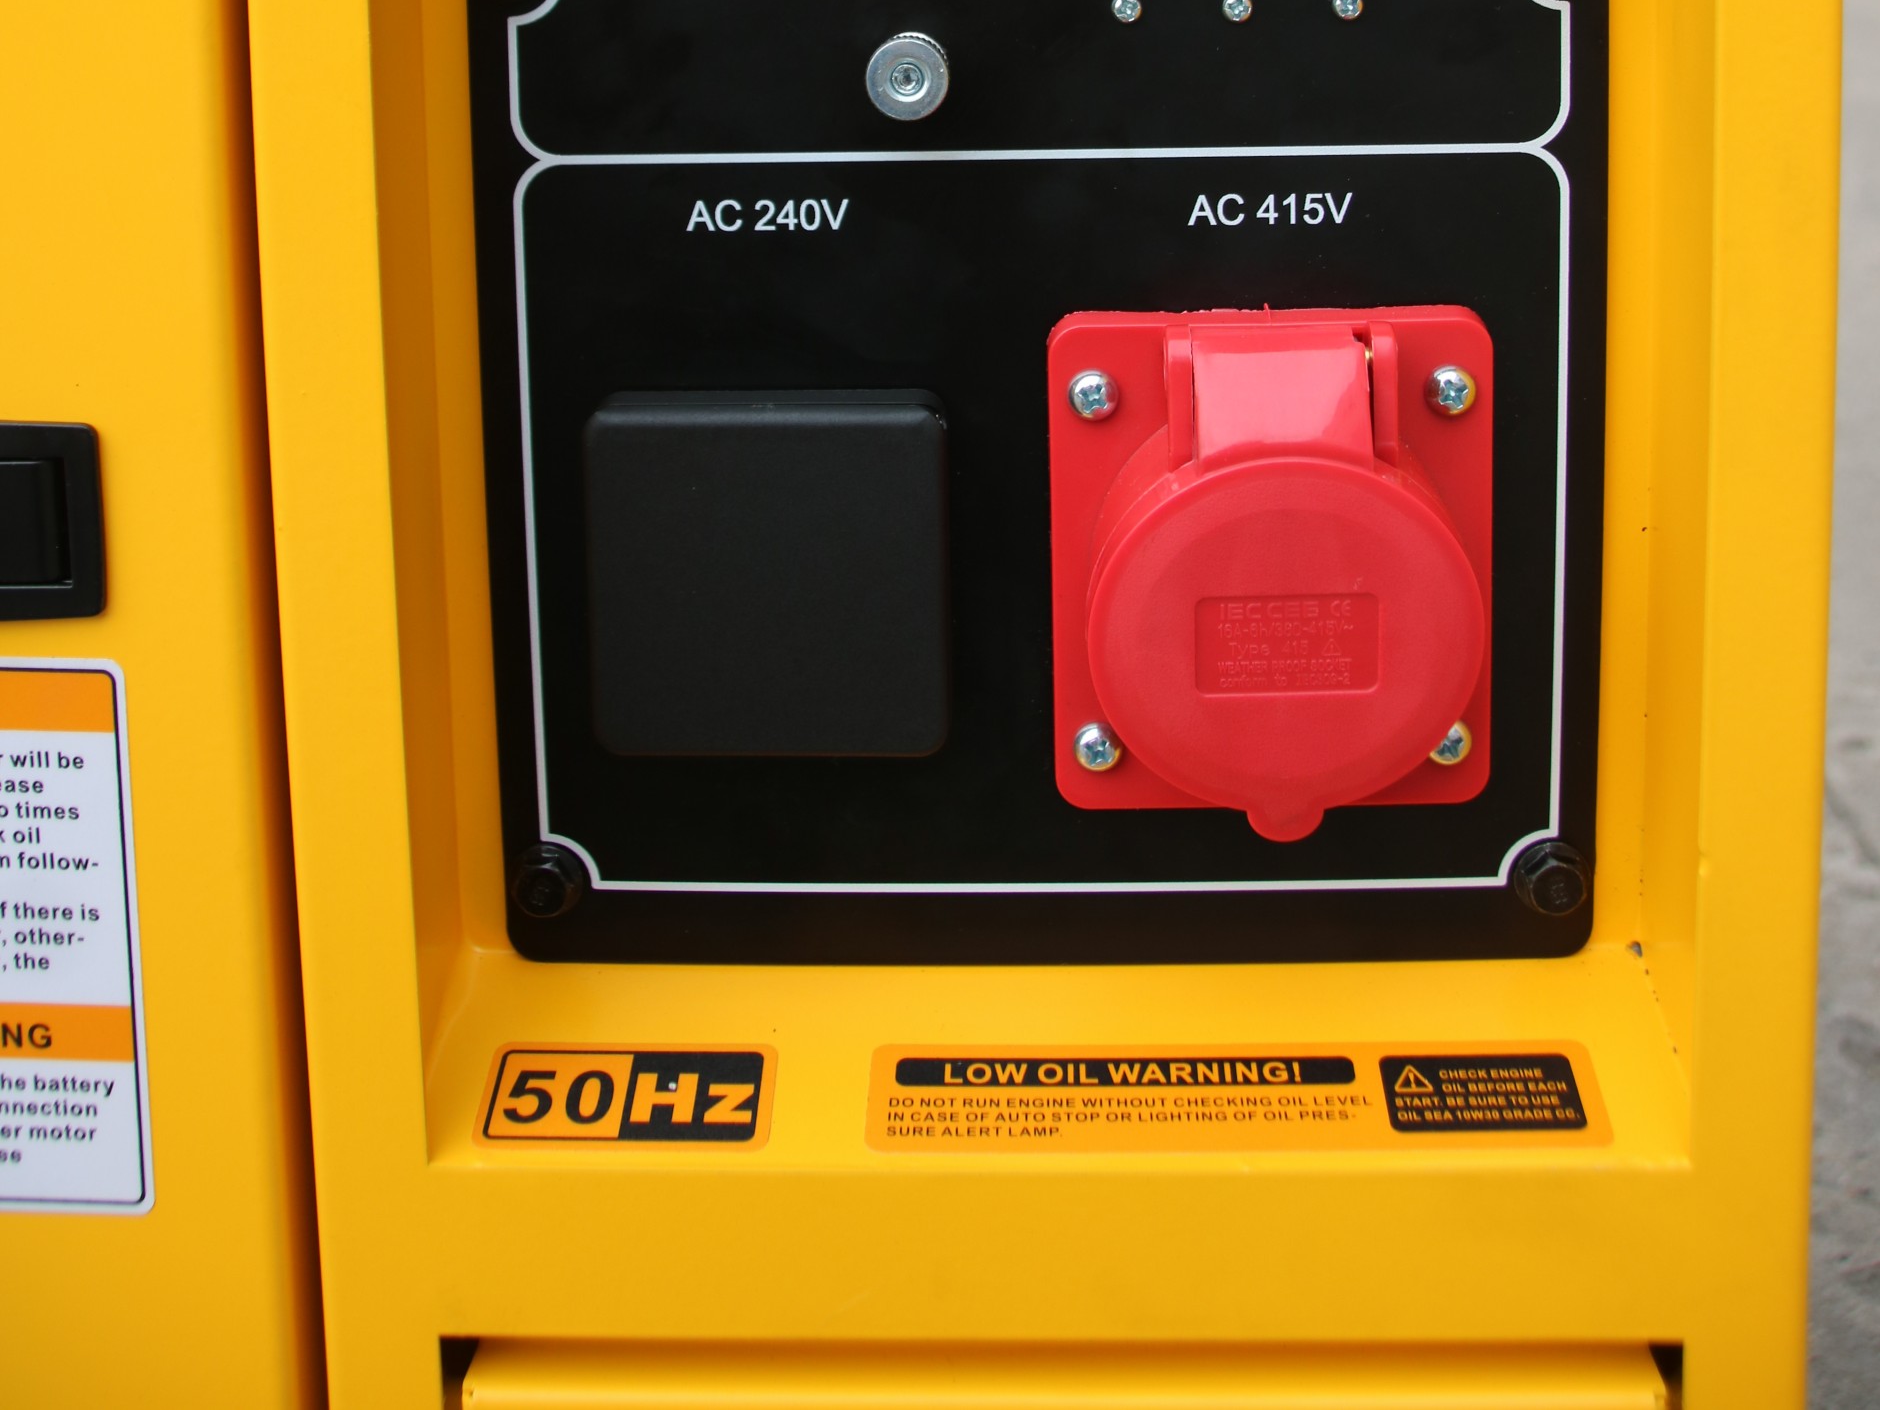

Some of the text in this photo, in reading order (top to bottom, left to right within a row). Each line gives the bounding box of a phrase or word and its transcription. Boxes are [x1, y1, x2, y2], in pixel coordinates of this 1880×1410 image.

[687, 199, 849, 232] AC 240V
[1187, 193, 1353, 227] AC 415V
[1220, 603, 1261, 620] IEC
[1217, 661, 1268, 674] WEATHER
[10, 751, 50, 768] will
[58, 751, 84, 769] be
[15, 801, 80, 820] times
[13, 827, 40, 844] oil
[18, 851, 99, 871] follow-
[13, 902, 73, 920] there
[80, 903, 100, 921] is
[14, 928, 85, 945] other-
[14, 952, 50, 970] the
[943, 1061, 1302, 1084] LOW OIL WARNING!
[1438, 1067, 1543, 1080] CHECK ENGINE
[34, 1073, 115, 1098] battery
[1441, 1080, 1568, 1094] OIL BEFORE EACH
[889, 1094, 1373, 1108] DO NOT RUN ENGINE WITHOUT CHECKING OIL LEVEL
[1446, 1095, 1466, 1108] BE
[1468, 1094, 1508, 1107] SURE
[1509, 1094, 1529, 1107] TO
[1531, 1094, 1561, 1106] USE
[887, 1109, 1357, 1123] IN CASE OF AUTO STOP OR LIGHTING OF OIL PRES-
[1397, 1109, 1422, 1122] OIL
[1456, 1109, 1500, 1121] 10W30
[1502, 1108, 1554, 1121] GRADE
[29, 1123, 97, 1141] motor
[886, 1126, 936, 1138] SURE
[941, 1126, 1003, 1138] ALERT
